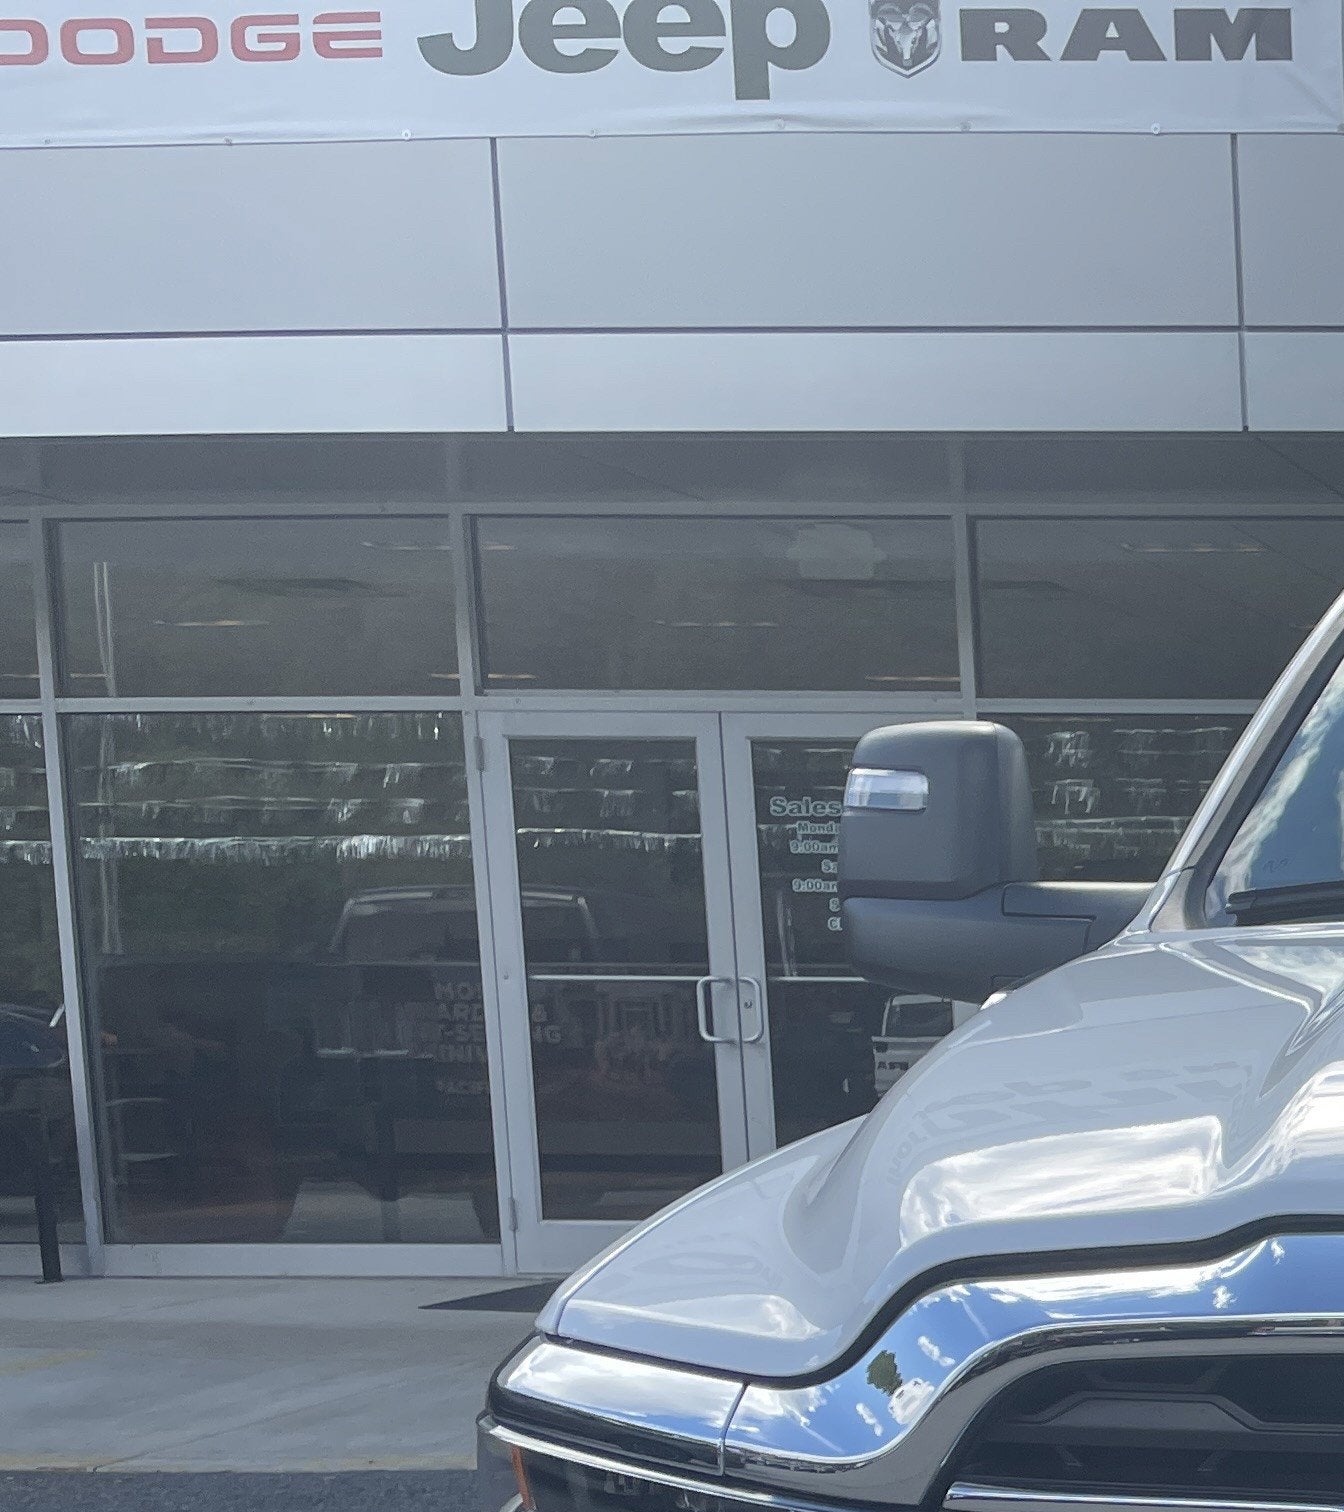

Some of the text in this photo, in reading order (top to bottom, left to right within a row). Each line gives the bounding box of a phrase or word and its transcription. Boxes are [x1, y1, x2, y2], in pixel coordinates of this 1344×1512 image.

[0, 0, 1293, 100] DODGE Jeep RAM
[769, 796, 842, 816] Sales
[797, 821, 839, 834] Mond
